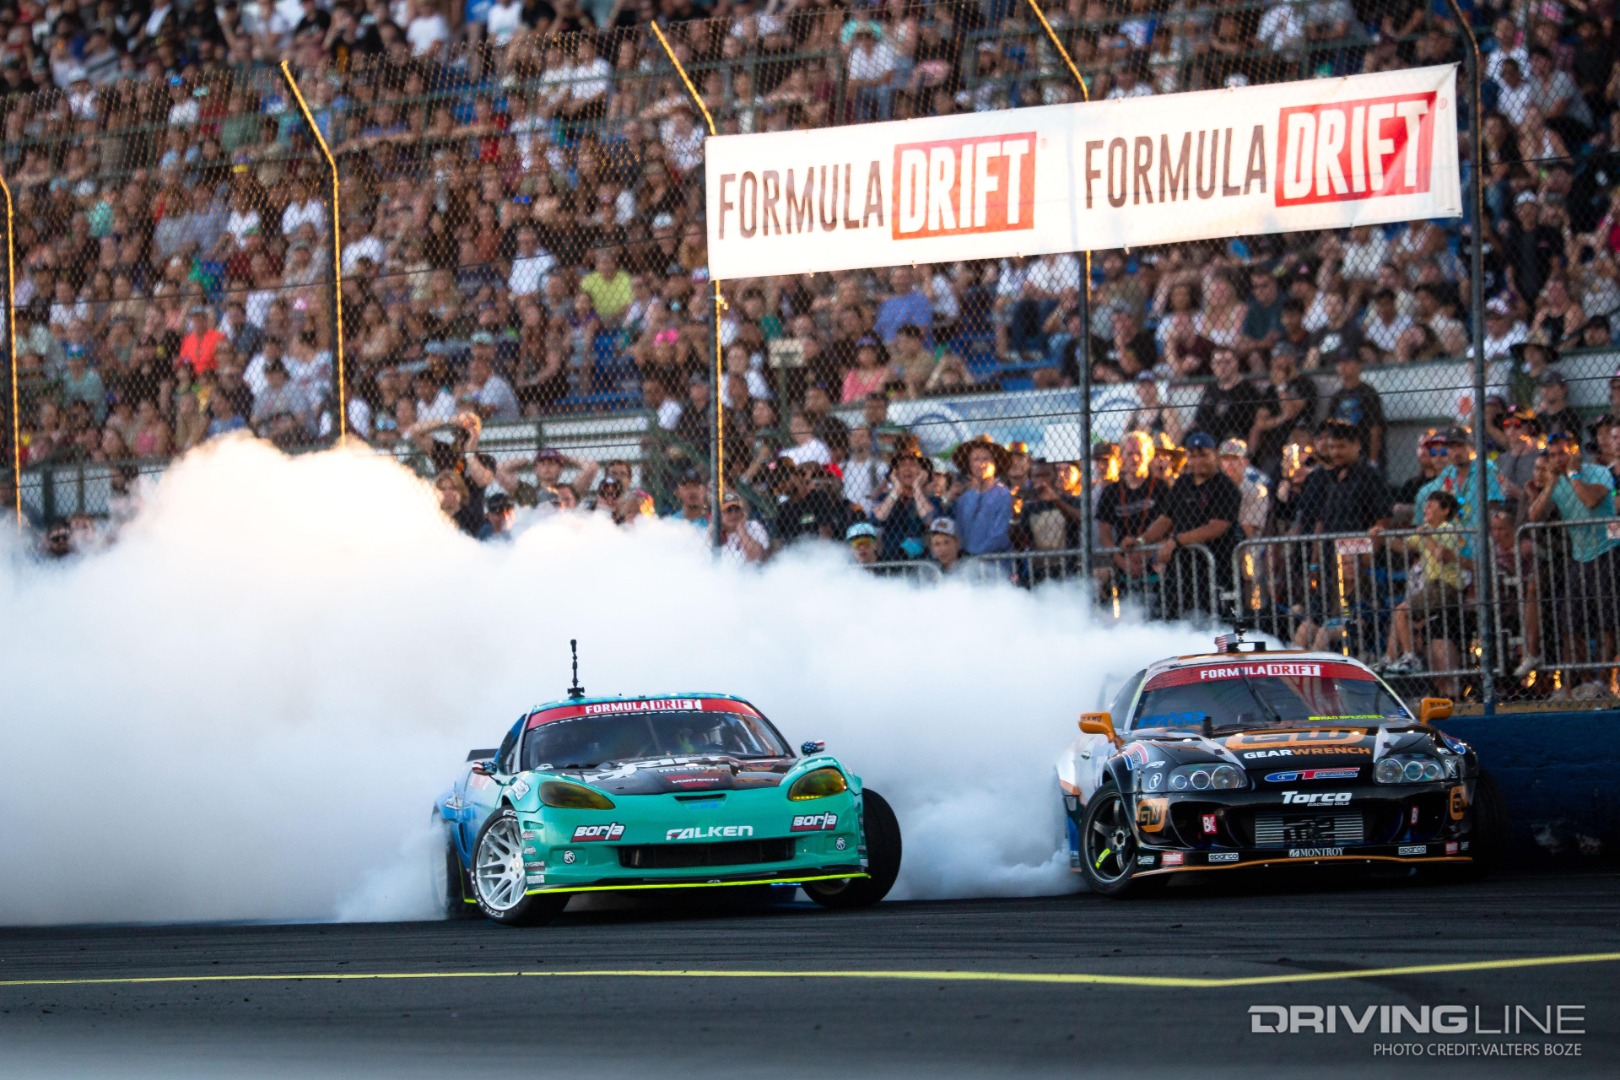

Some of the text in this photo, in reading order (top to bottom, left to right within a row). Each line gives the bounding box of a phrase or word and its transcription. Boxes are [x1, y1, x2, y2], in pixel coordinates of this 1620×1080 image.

[1085, 101, 1430, 209] FORMULA DRIFT
[718, 140, 1031, 240] FORMULA DRIFT
[1270, 665, 1318, 675] DRIFT
[585, 699, 698, 714] FORMULA DRIFT
[1244, 747, 1371, 760] GEARWRENCH
[1281, 790, 1353, 804] Torco
[666, 825, 753, 840] FALKEN
[1300, 847, 1344, 857] MONTROY
